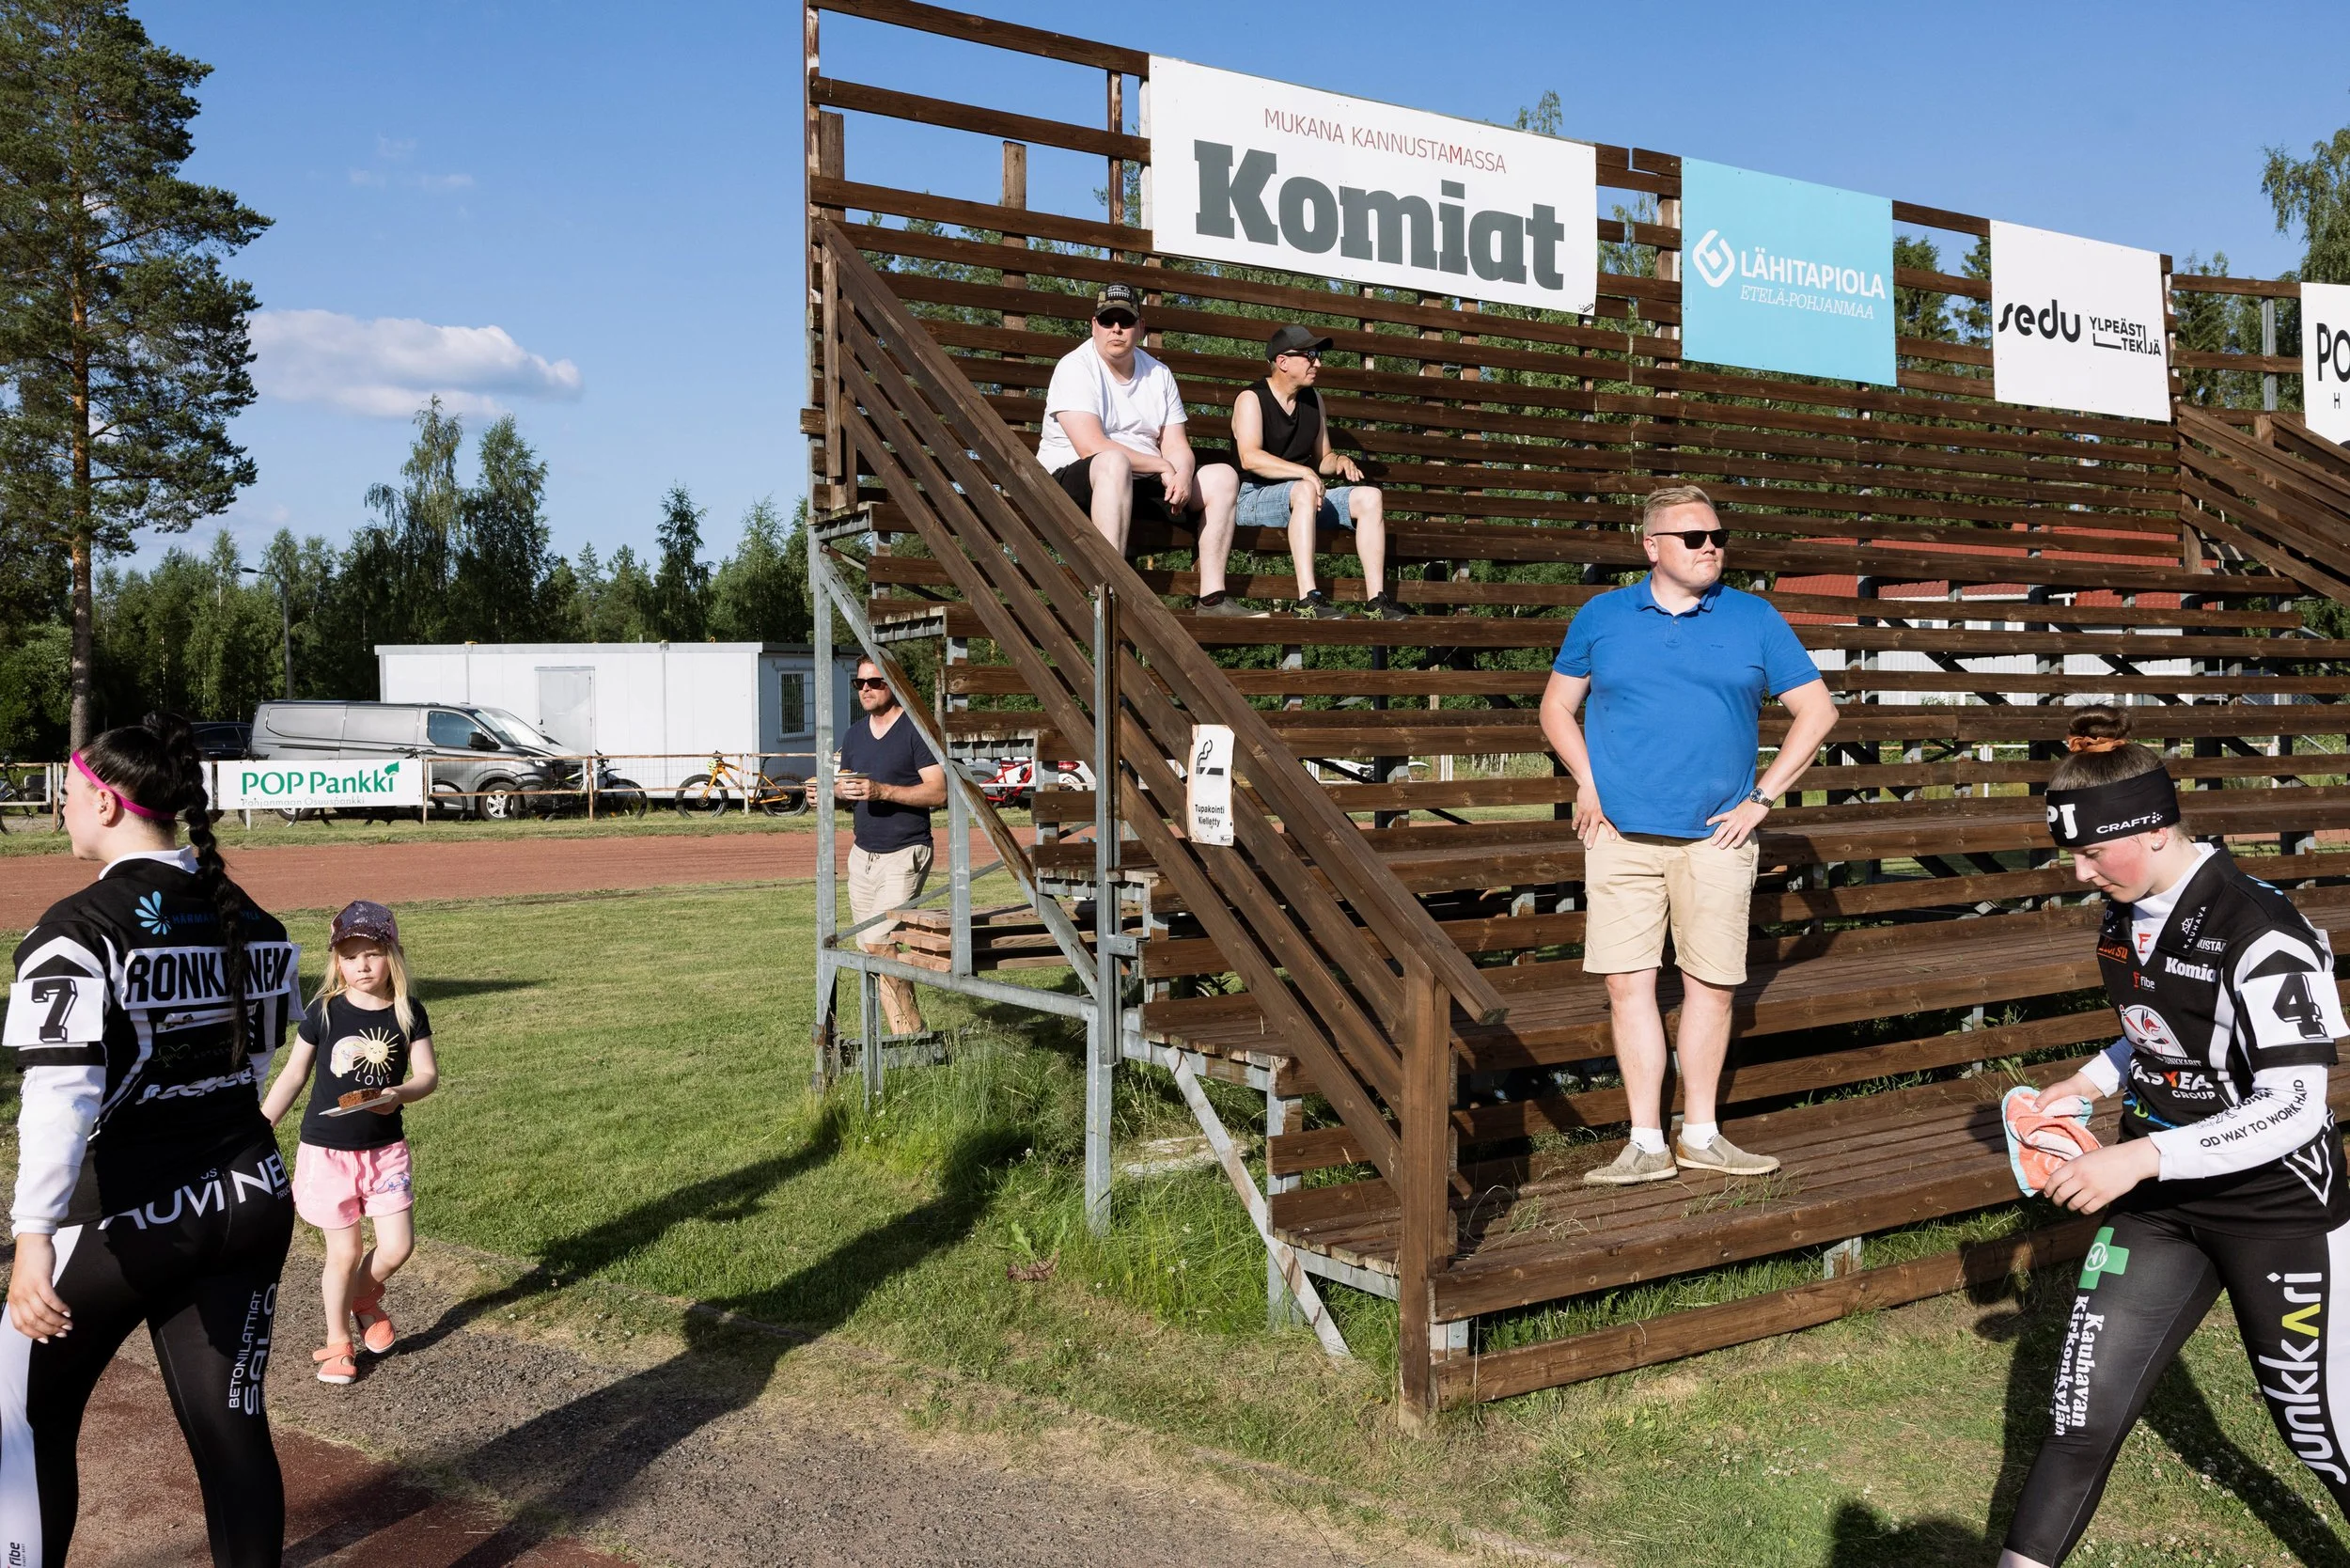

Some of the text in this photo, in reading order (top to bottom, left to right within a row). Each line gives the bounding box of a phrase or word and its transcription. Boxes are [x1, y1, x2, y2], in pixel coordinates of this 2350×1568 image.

[1264, 107, 1507, 174] MUKANA KANNUSTAMASSA
[1194, 139, 1565, 290] Komiat
[1741, 246, 1886, 300] LÄHITAPIOLA
[1740, 284, 1874, 320] ETELÄ-POHJANMAA
[1998, 299, 2081, 343] sedu
[2089, 317, 2146, 340] YLPEÄSTI
[2121, 333, 2161, 356] TEKIJÄ
[242, 766, 396, 794] POP Pankki
[1195, 804, 1225, 814] Tupakointi
[1198, 816, 1220, 827] Kielletty
[2096, 815, 2151, 834] CRAFT
[2183, 906, 2207, 949] KAUHAVA
[31, 979, 78, 1043] 7
[2272, 972, 2328, 1039] 4
[354, 1071, 392, 1086] LOVE
[2171, 1090, 2216, 1100] GROUP
[2221, 1126, 2248, 1143] WAY
[2248, 1121, 2267, 1134] TO
[2266, 1103, 2302, 1126] WORK
[229, 1291, 262, 1408] BETONILATTIAT
[244, 1283, 276, 1415] SALO
[2055, 1294, 2090, 1435] Kirkonkylän
[2072, 1311, 2105, 1428] Kauhavan
